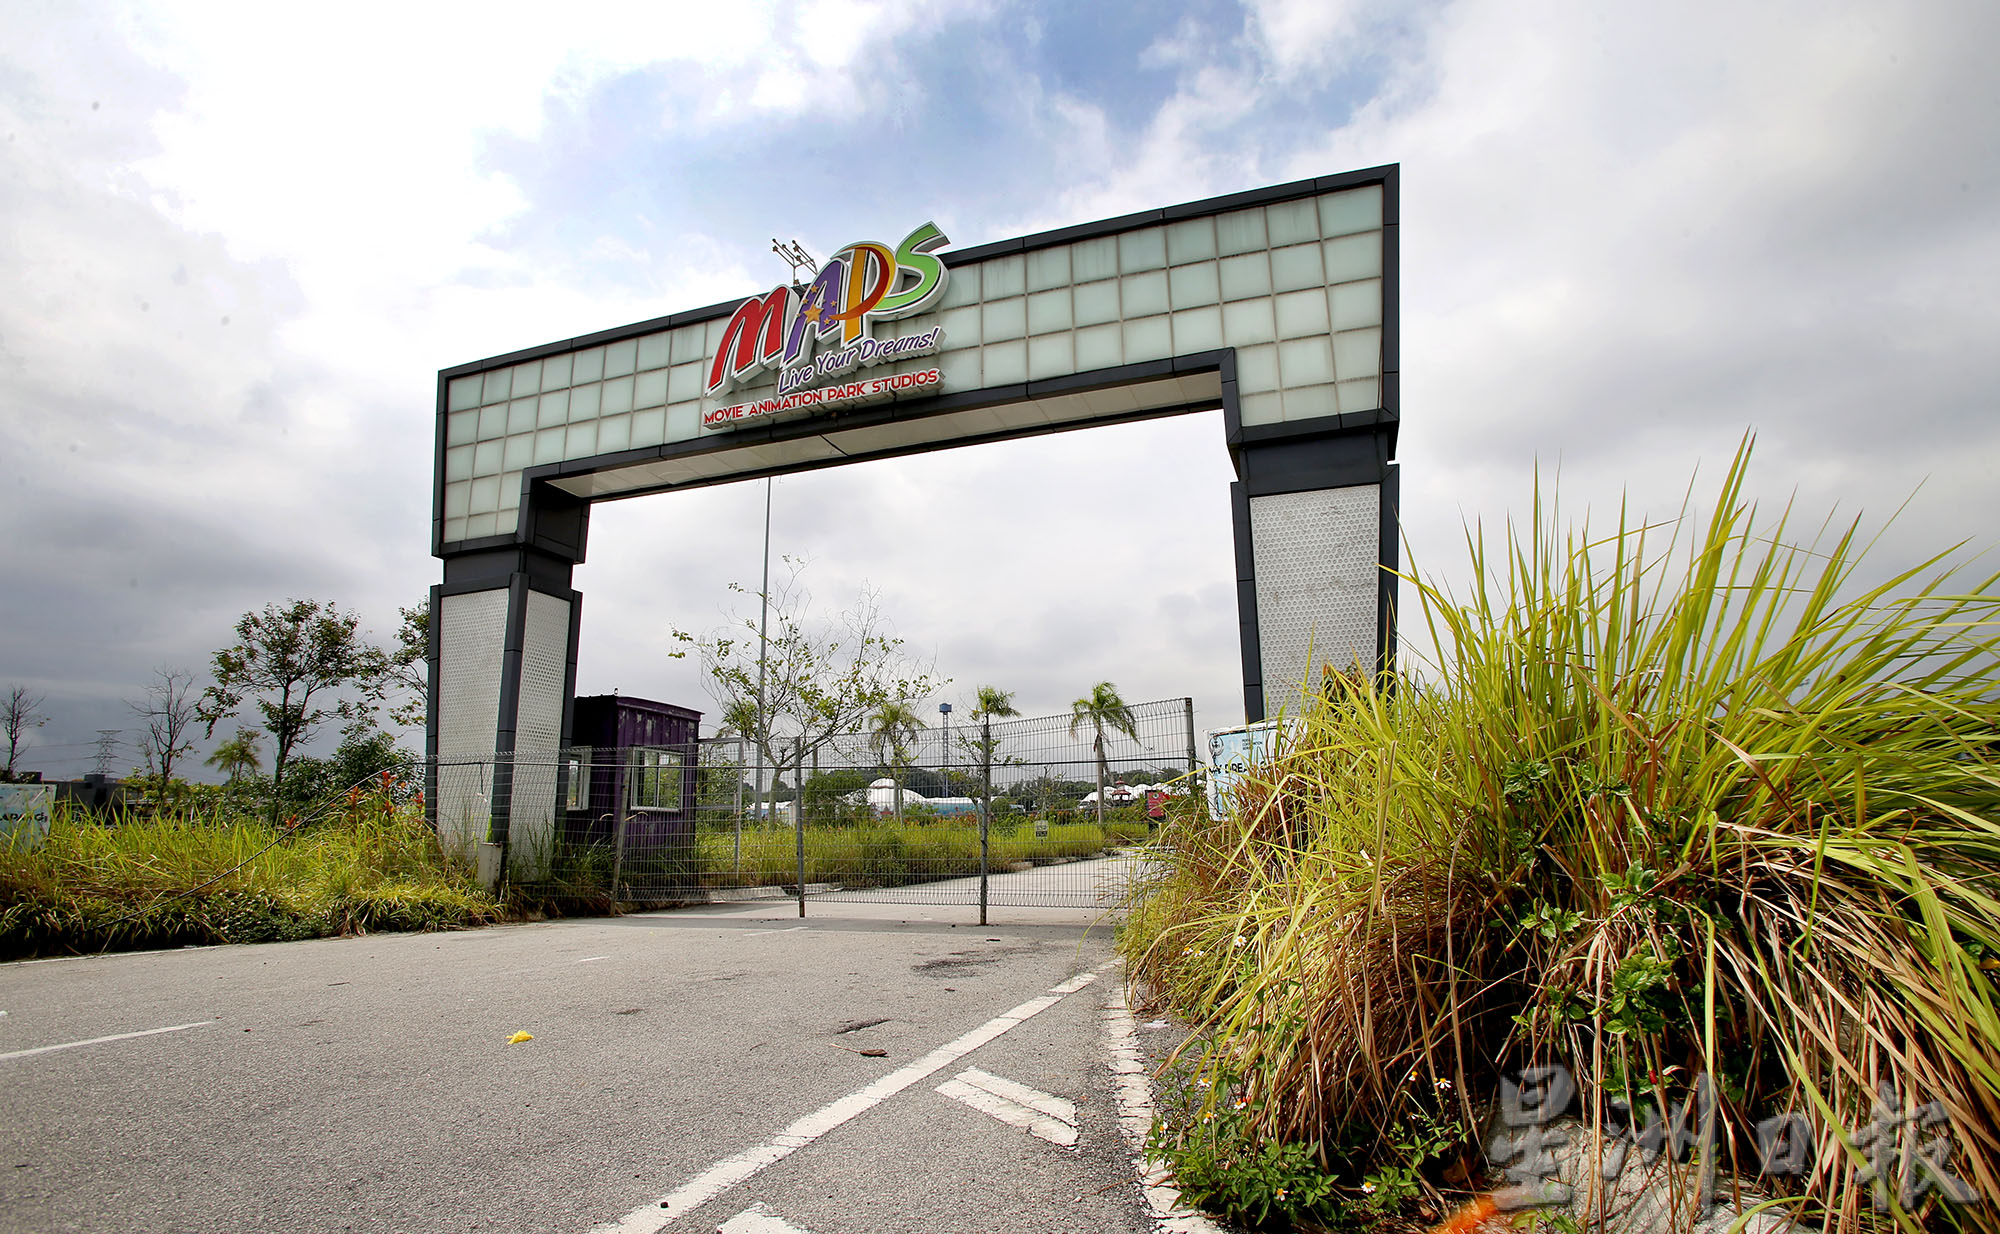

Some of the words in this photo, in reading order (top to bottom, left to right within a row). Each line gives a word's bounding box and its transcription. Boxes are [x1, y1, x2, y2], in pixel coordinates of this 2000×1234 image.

[705, 221, 950, 397] MAPS
[778, 364, 814, 394] Live
[816, 348, 857, 375] Your
[859, 326, 942, 361] Dreams!
[703, 405, 744, 425] MOVIE
[748, 390, 823, 416] ANIMATION
[827, 381, 867, 401] PARK
[872, 369, 939, 394] STUDIOS
